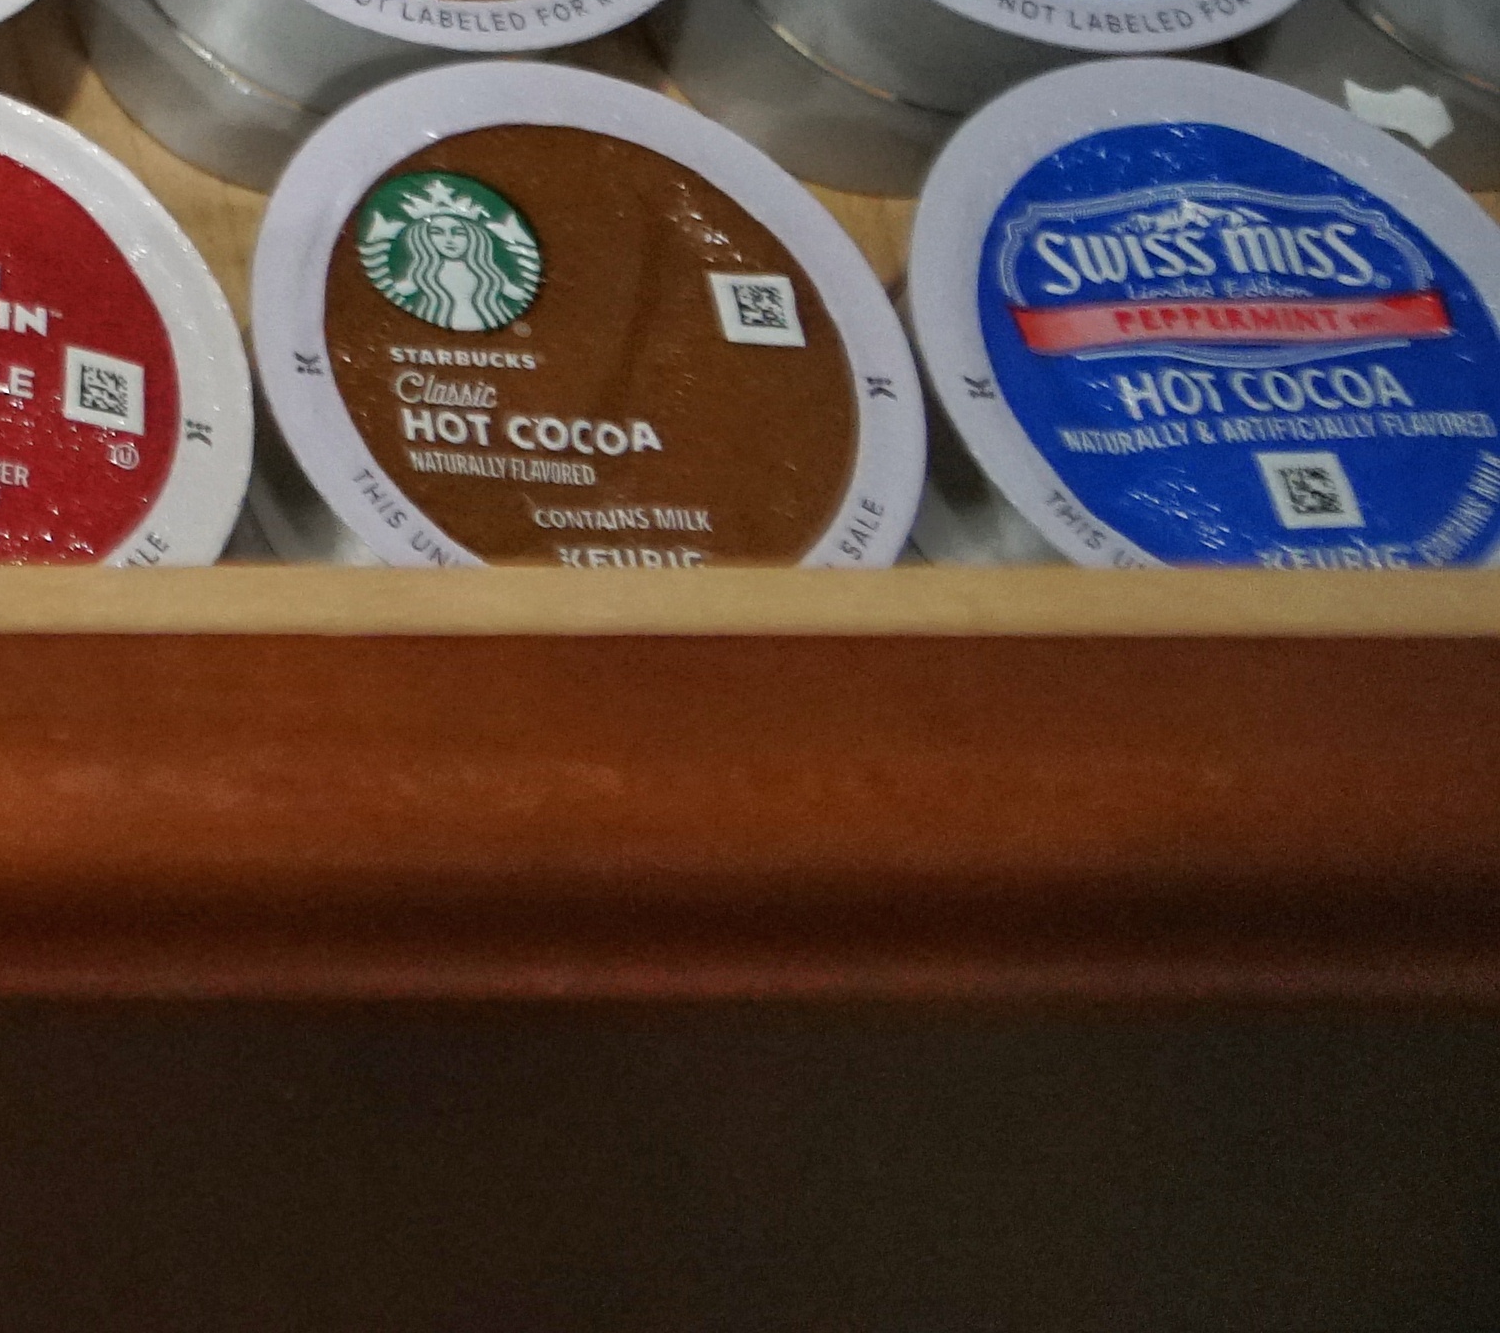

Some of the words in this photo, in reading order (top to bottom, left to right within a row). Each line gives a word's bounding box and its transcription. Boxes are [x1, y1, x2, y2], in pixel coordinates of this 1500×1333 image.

[1112, 305, 1339, 336] PEPPERMINT
[388, 345, 537, 372] STARBUCKS
[393, 368, 498, 412] Classic
[1116, 372, 1224, 420] HOT
[1234, 365, 1411, 413] COCOA
[402, 408, 495, 449] HOT
[508, 417, 662, 459] COCOA
[409, 449, 503, 481] NATURALLY
[507, 458, 597, 489] FLAVORED
[533, 505, 644, 534] CONTAINS
[646, 508, 712, 534] MILK
